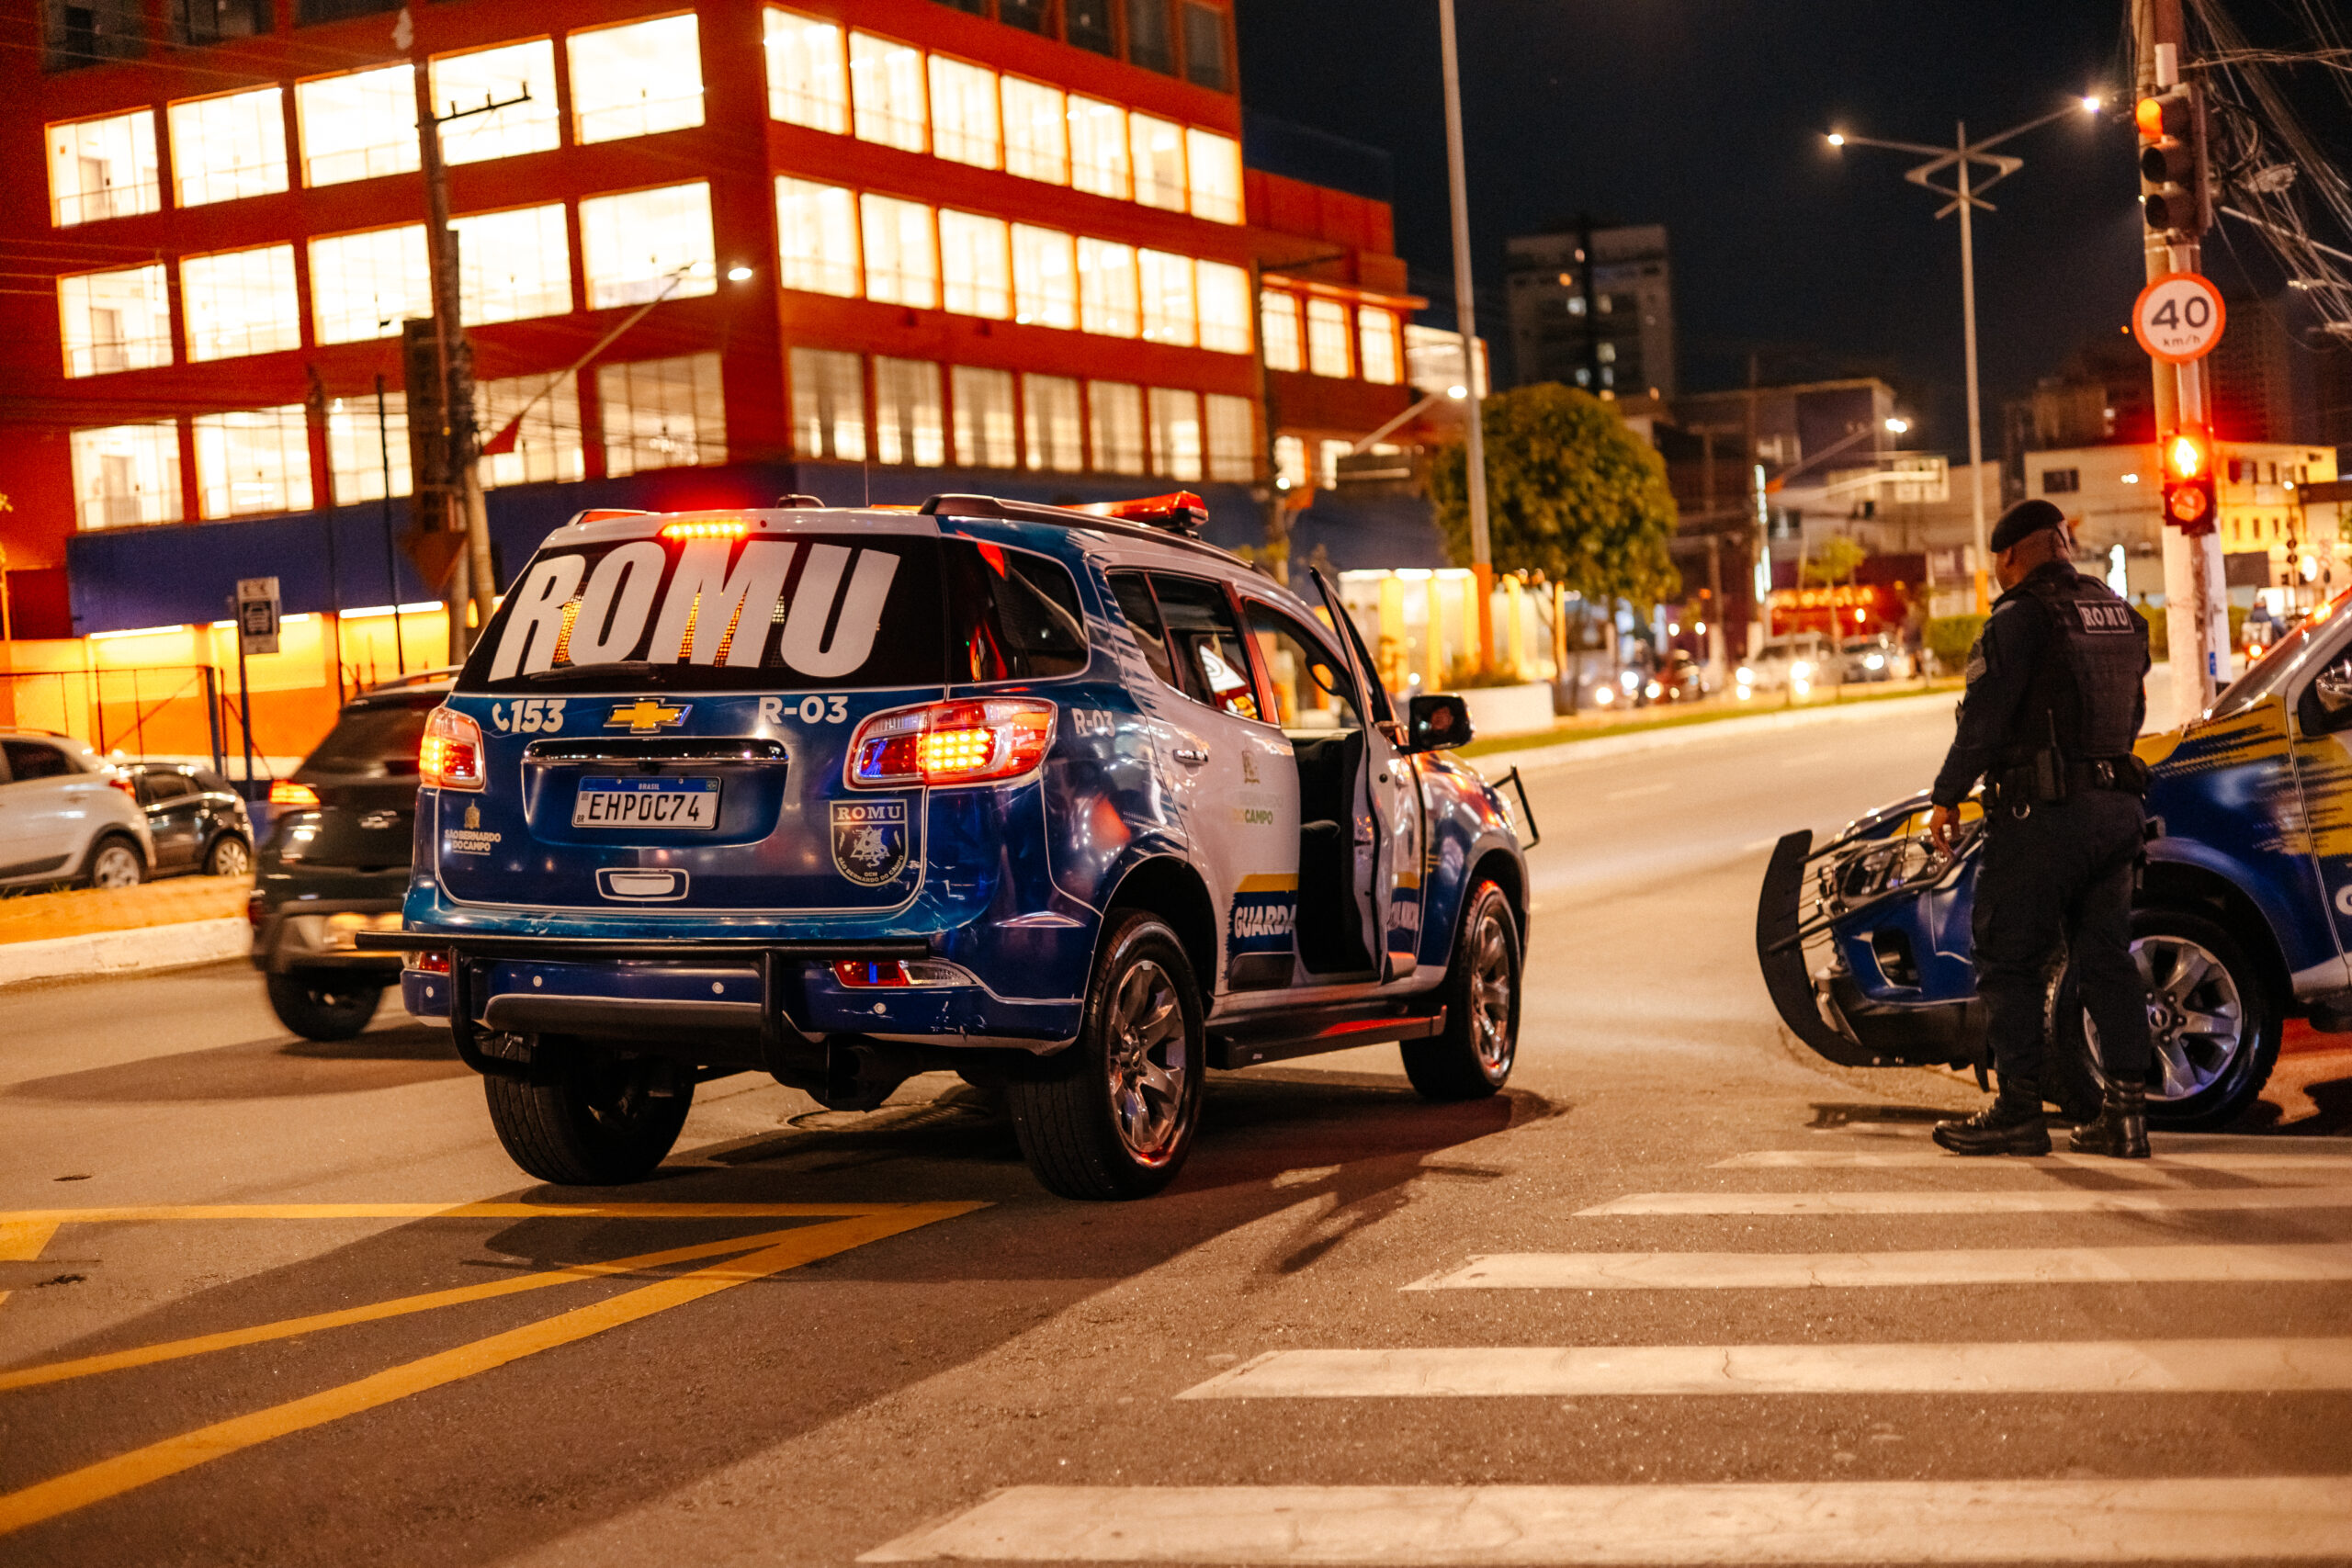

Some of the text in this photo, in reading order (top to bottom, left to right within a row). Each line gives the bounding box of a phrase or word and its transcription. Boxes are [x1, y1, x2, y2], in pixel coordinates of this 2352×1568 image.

[2151, 296, 2210, 331] 40
[2163, 334, 2201, 347] km/h
[488, 537, 901, 682] ROMU
[2079, 606, 2129, 626] ROMU
[510, 699, 567, 733] 153
[758, 695, 848, 725] R-03
[1071, 707, 1116, 738] R-03
[638, 783, 661, 791] BRASIL
[576, 814, 585, 823] BR
[837, 806, 901, 820] ROMU
[1245, 808, 1273, 825] CAMPO
[459, 830, 502, 842] BERNARDO
[463, 840, 492, 852] CAMPO
[845, 868, 879, 883] BERNARDO
[1234, 904, 1297, 939] GUARDA
